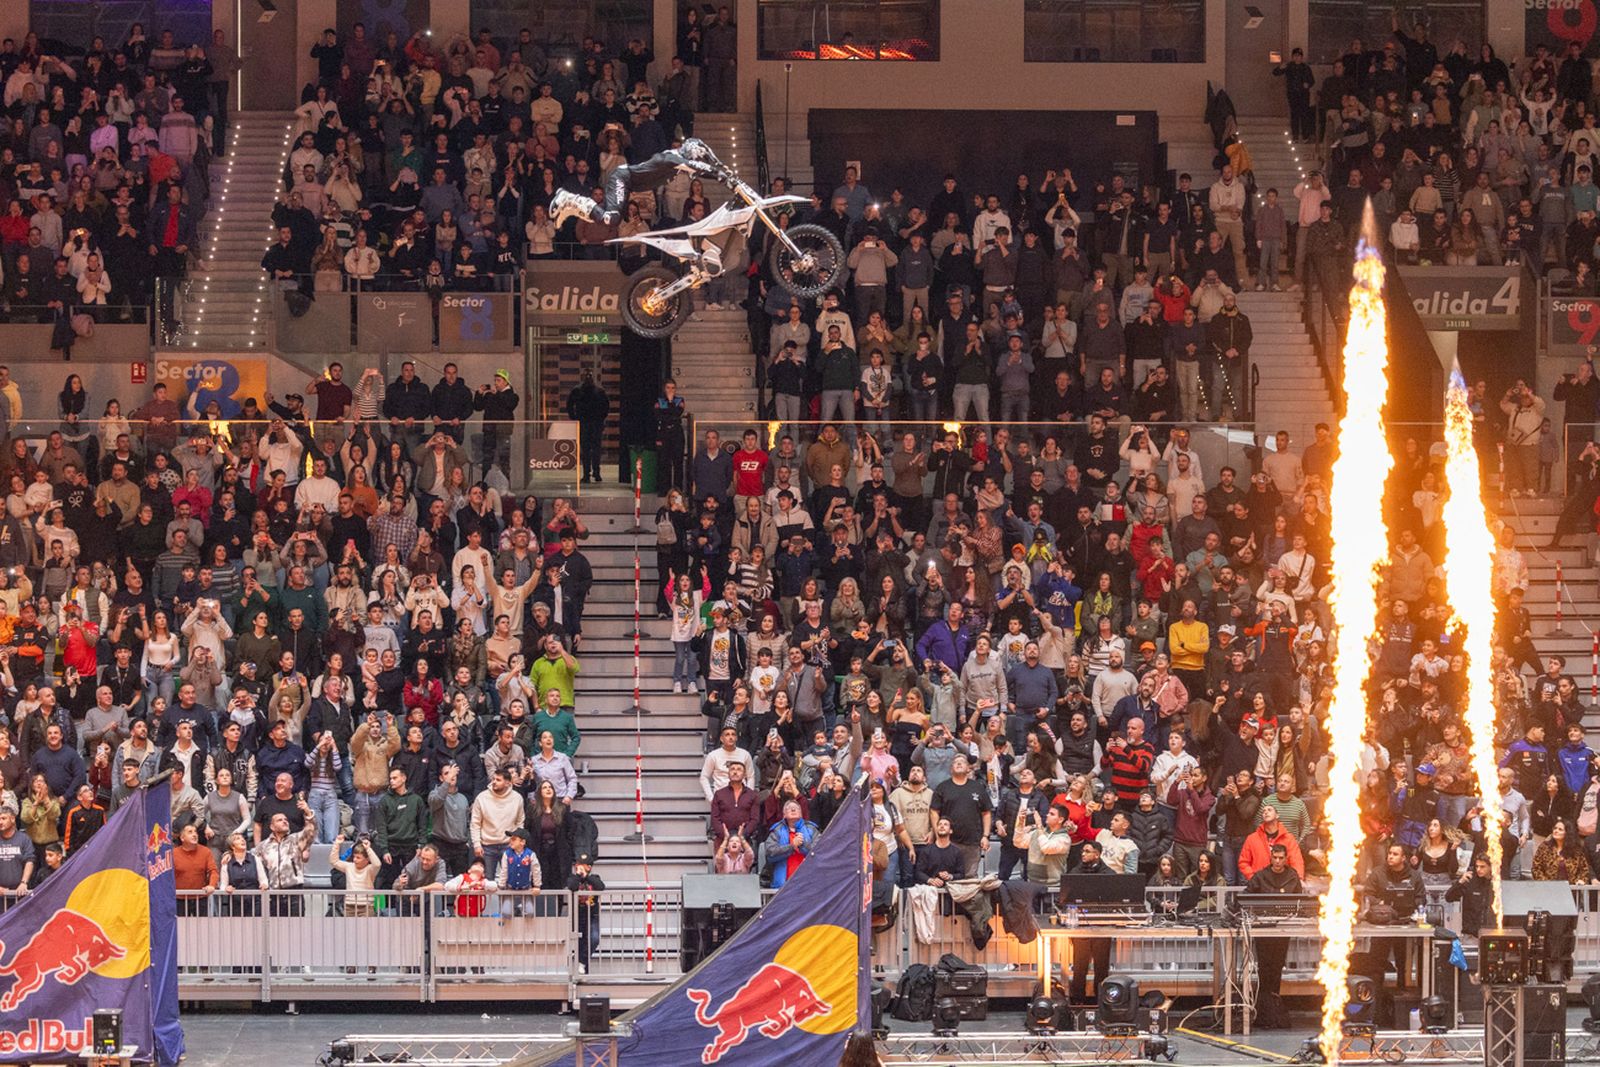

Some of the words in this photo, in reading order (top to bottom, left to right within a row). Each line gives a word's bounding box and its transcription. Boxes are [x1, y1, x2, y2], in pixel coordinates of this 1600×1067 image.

[444, 296, 486, 308] Sector
[526, 286, 619, 310] Salida
[1412, 290, 1488, 315] alida
[1491, 282, 1521, 315] 4
[1552, 300, 1592, 312] Sector
[460, 294, 495, 342] 8
[1446, 320, 1470, 328] SALIDA
[1567, 299, 1600, 346] 9
[156, 361, 227, 380] Sector
[530, 458, 564, 469] Sector
[552, 439, 577, 471] 8
[740, 461, 760, 471] 93
[0, 1018, 39, 1054] ed
[41, 1017, 94, 1054] Bul
